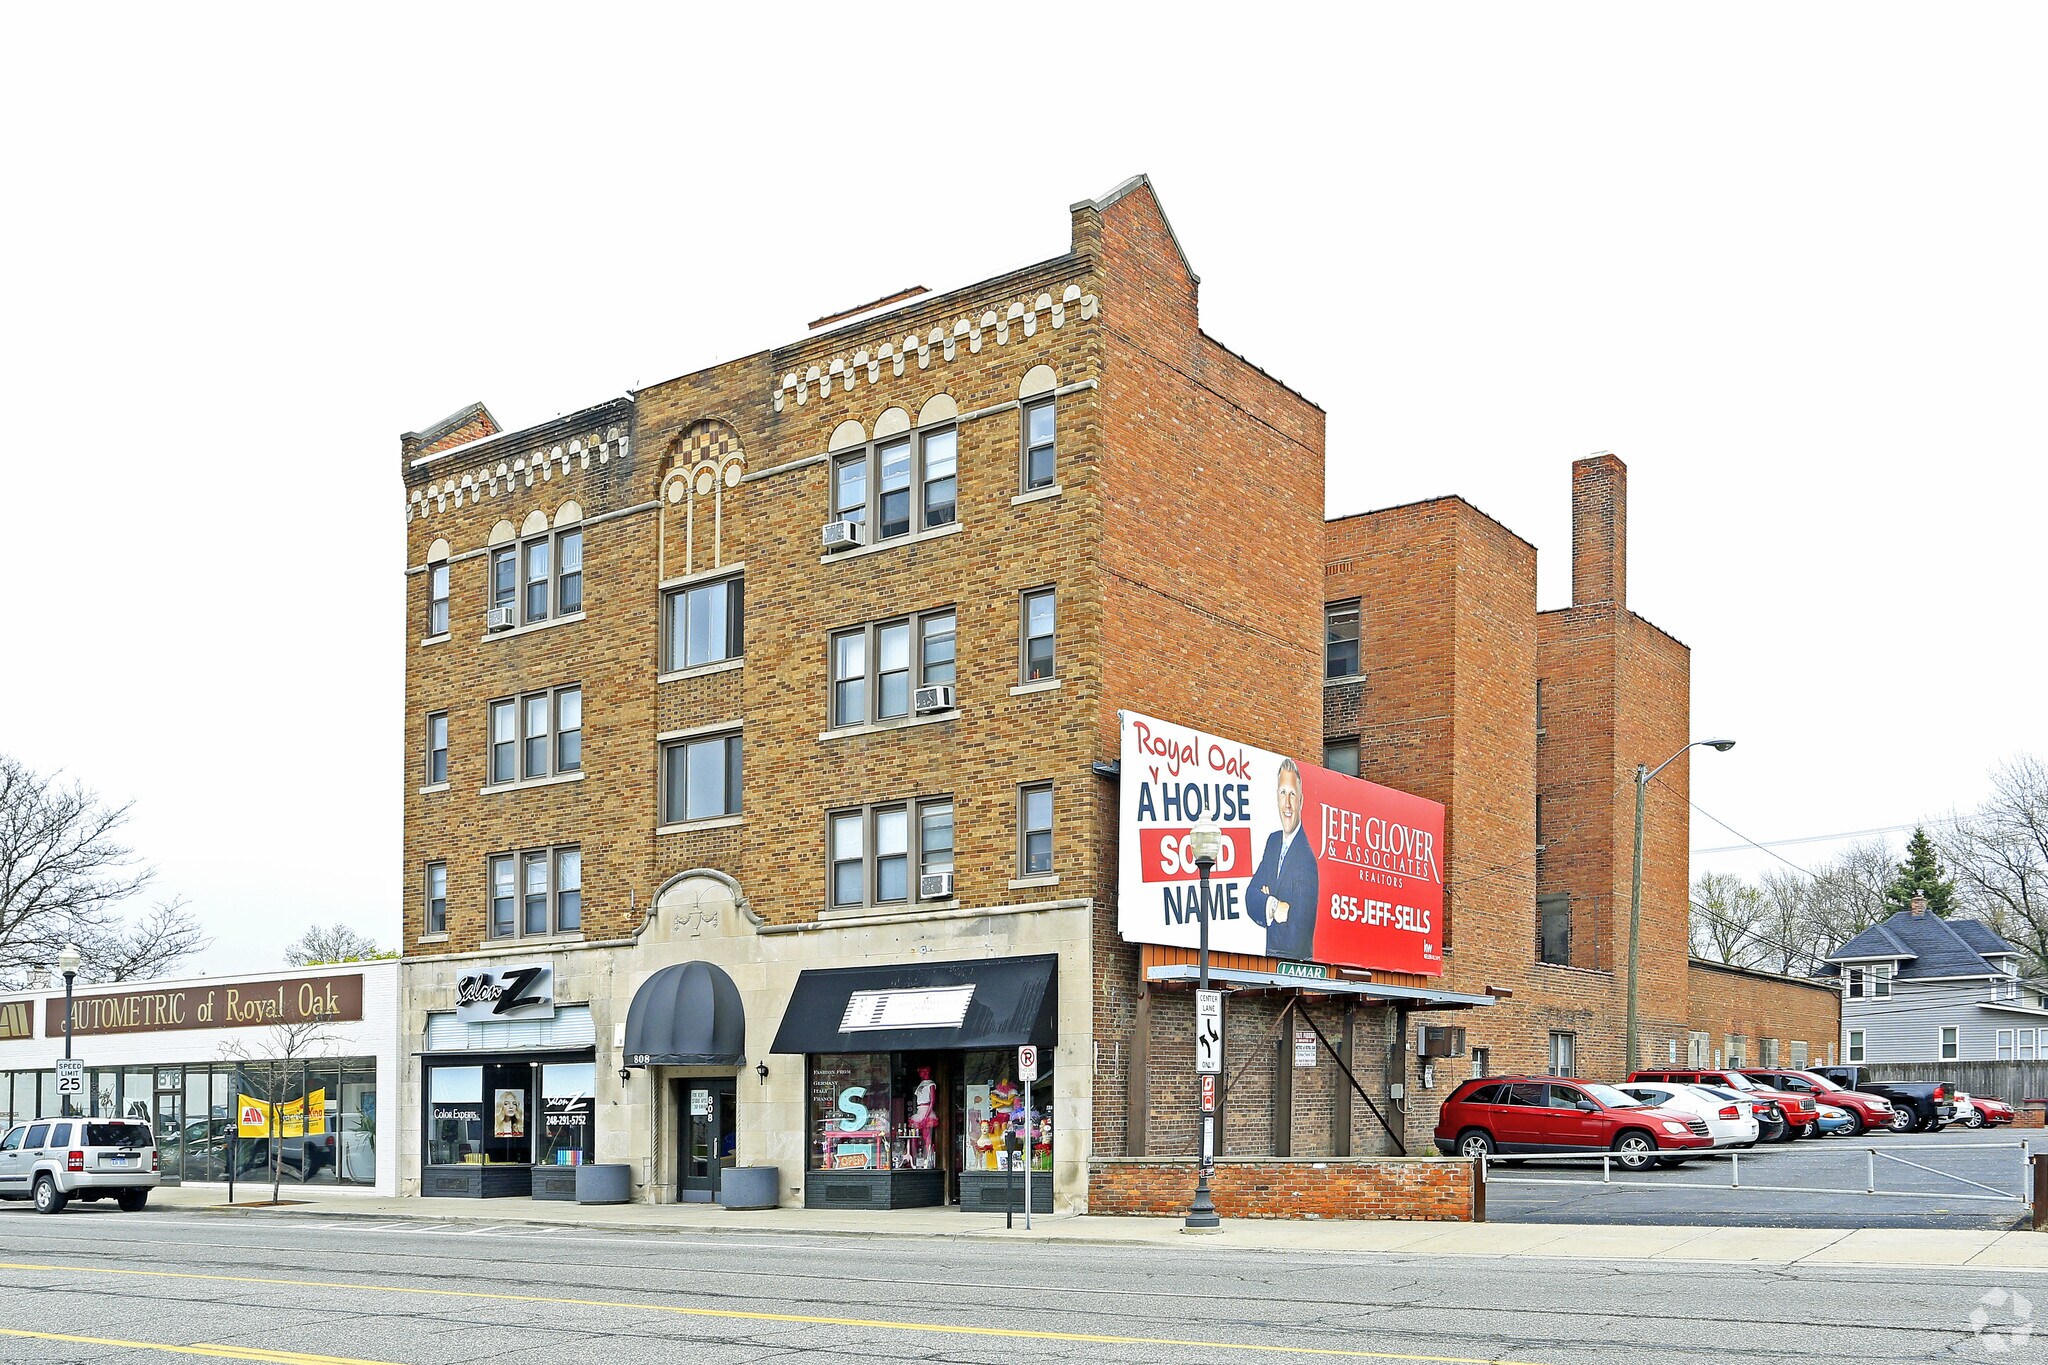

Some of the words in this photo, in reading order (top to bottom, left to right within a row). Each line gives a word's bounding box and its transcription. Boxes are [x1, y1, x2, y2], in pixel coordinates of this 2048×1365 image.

[1133, 721, 1199, 777] Royal
[1208, 744, 1251, 780] Oak
[1137, 782, 1157, 821] A
[1162, 782, 1250, 821] HOUSE
[1160, 834, 1236, 875] SOD
[1318, 803, 1361, 859] JEFF
[1365, 817, 1440, 884] GLOVER
[1328, 841, 1336, 857] &
[1346, 845, 1429, 877] ASSOCIATES
[1359, 869, 1403, 888] REALTORS
[1163, 883, 1240, 925] NAME
[1330, 893, 1431, 934] 855-JEFF-SELLS
[1282, 964, 1322, 978] LAMAR
[455, 973, 503, 1006] Salon
[492, 967, 546, 1014] Z
[1200, 994, 1218, 1002] CENTER
[60, 992, 186, 1032] AUTOMETRIC
[197, 990, 215, 1022] of
[226, 985, 284, 1023] Royal
[299, 982, 341, 1017] Oak
[1202, 1004, 1215, 1012] LANE
[633, 1054, 650, 1064] 808
[1202, 1061, 1215, 1069] ONLY
[59, 1078, 81, 1091] 25
[546, 1096, 569, 1108] Salon
[564, 1090, 587, 1112] Z
[838, 1086, 868, 1132] S
[434, 1108, 453, 1119] Color
[453, 1109, 476, 1120] Experts
[546, 1115, 586, 1126] 248-291-5752
[840, 1154, 865, 1167] OPEN
